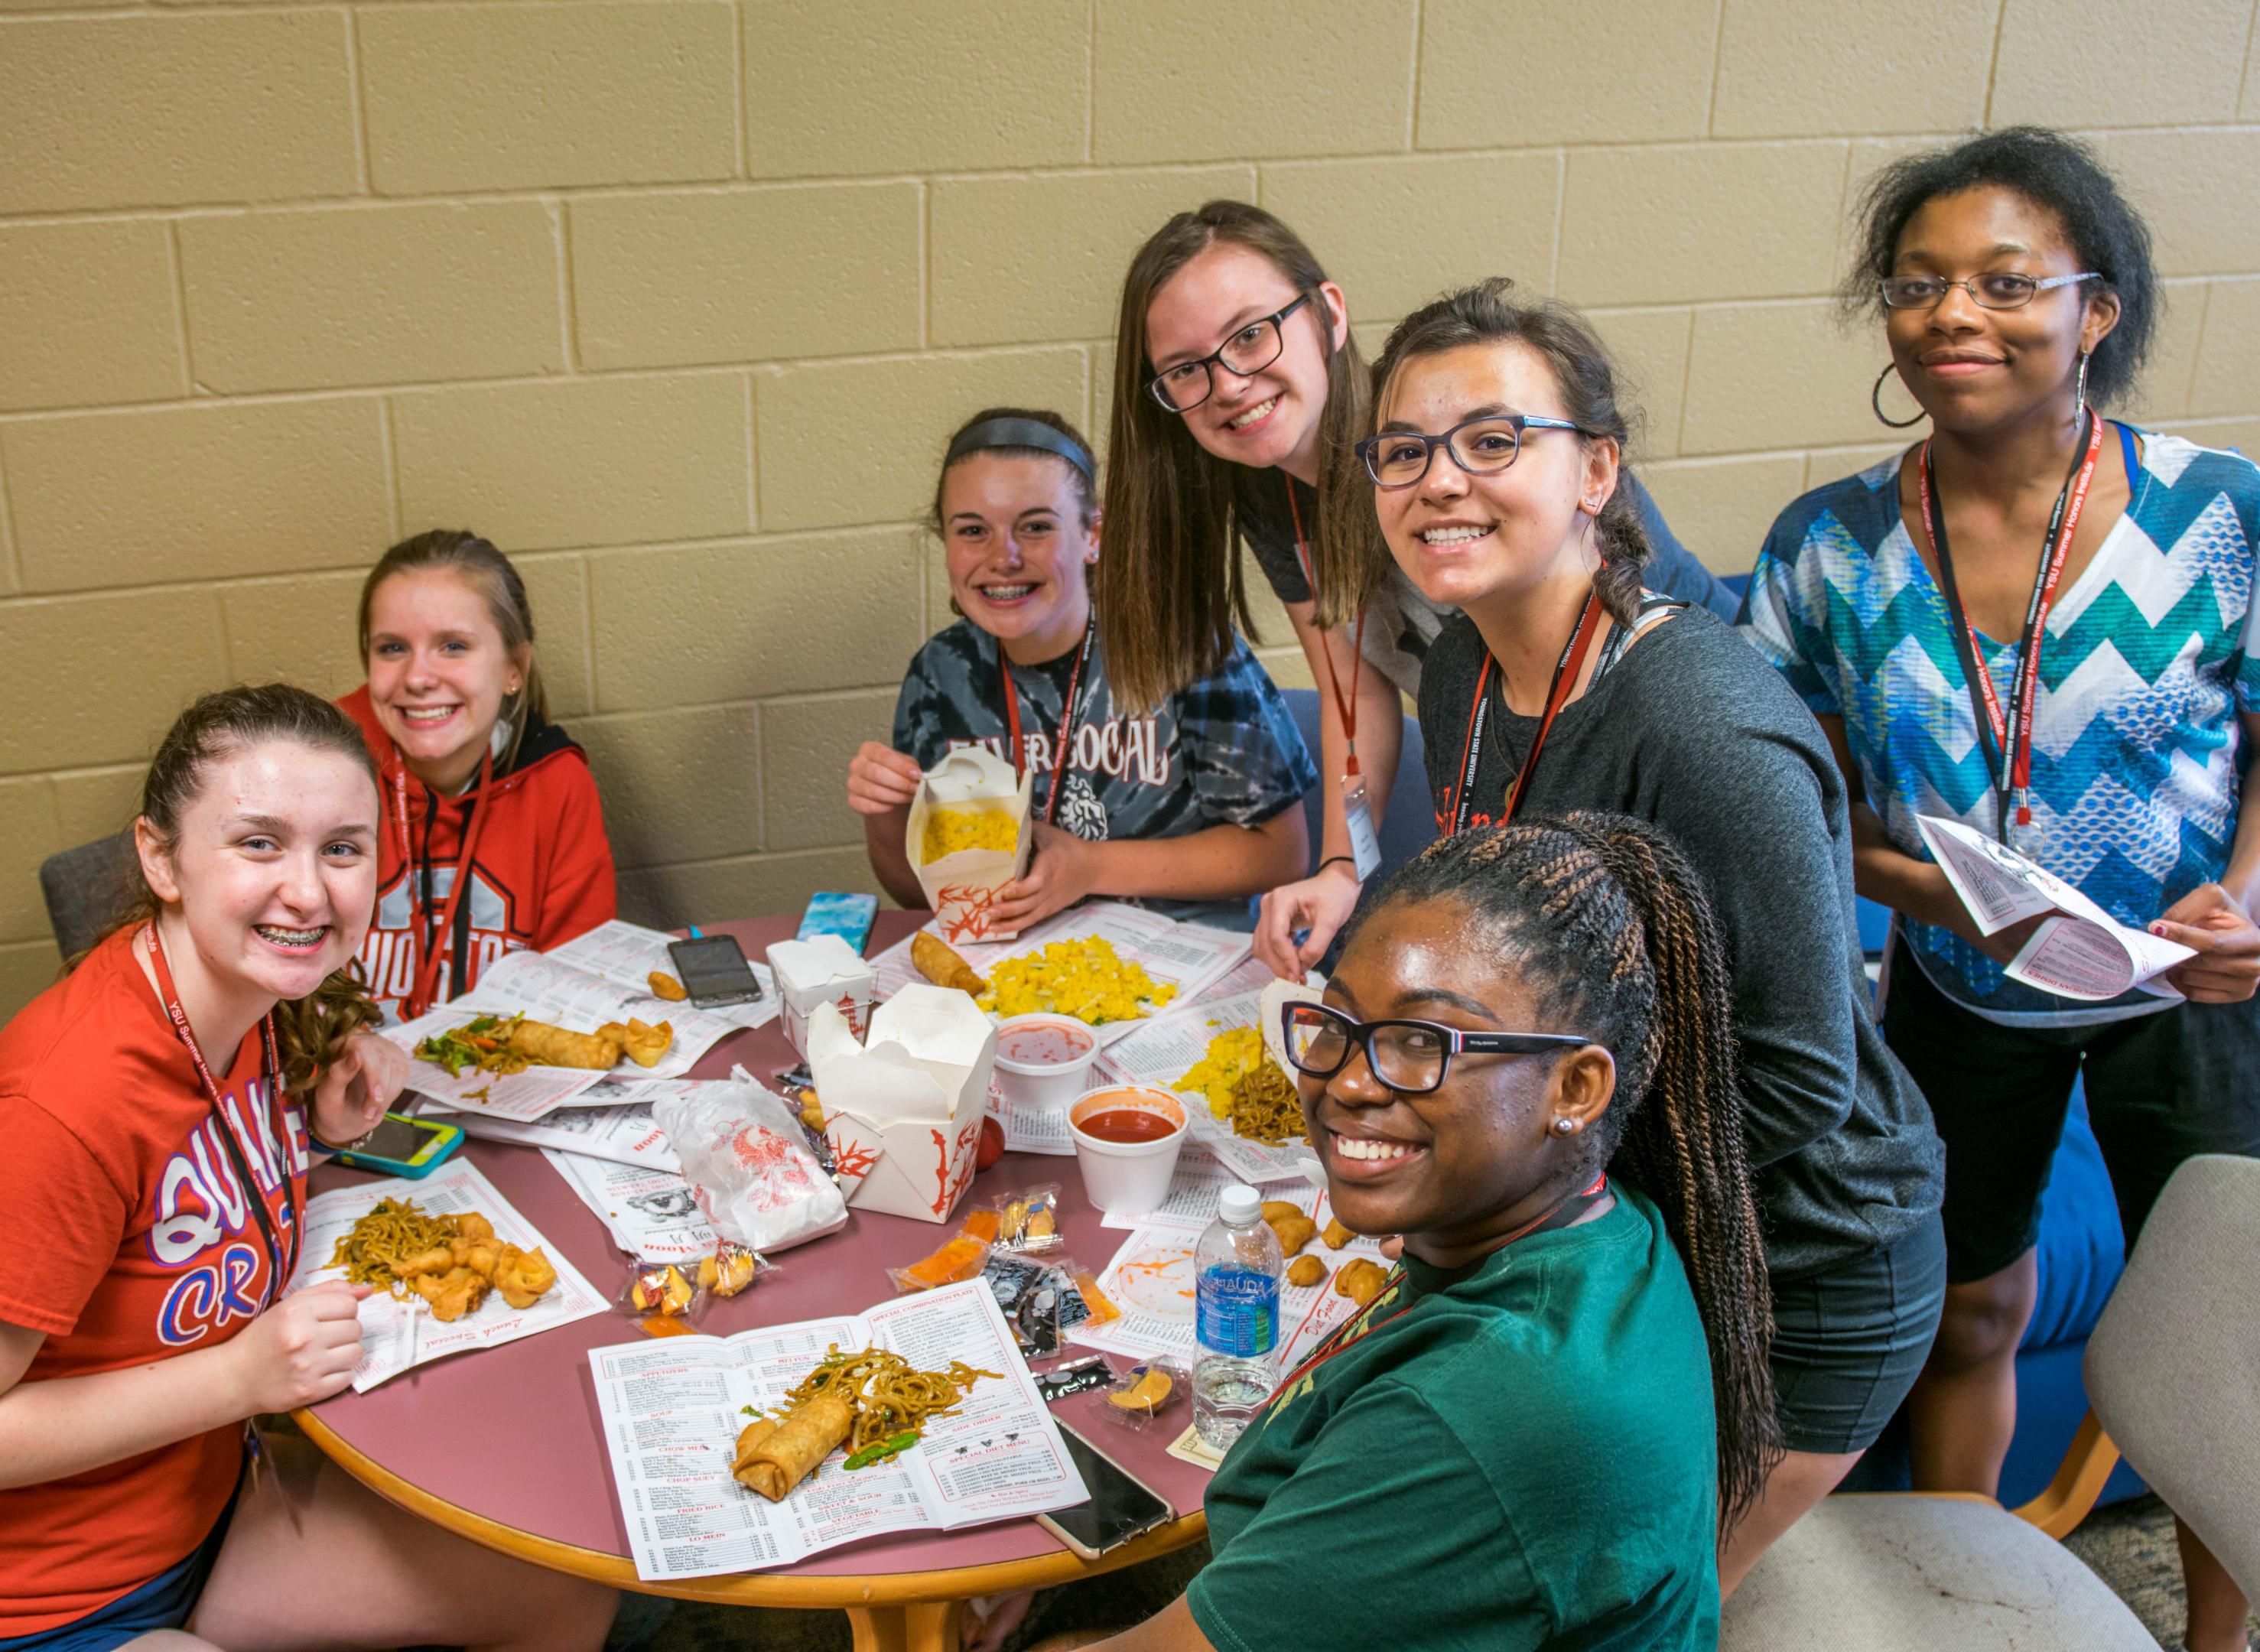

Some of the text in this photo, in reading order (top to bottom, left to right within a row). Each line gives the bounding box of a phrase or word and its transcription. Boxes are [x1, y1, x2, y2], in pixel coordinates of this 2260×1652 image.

[2090, 433, 2102, 450] YSU
[2045, 460, 2094, 590] YSU Summer Honors Institute
[2020, 601, 2049, 737] YSU Summer Honors Institute
[1977, 667, 2005, 736] Honors Institute
[1473, 697, 1488, 737] YOUNGSTOWN
[1471, 737, 1481, 754] STATE
[1465, 753, 1478, 788] UNIVERSITY
[2027, 970, 2057, 987] DISHES
[169, 1000, 186, 1026] YSU
[178, 1025, 202, 1065] Summer
[200, 1063, 218, 1097] Honors
[643, 1243, 695, 1255] Moon
[873, 1289, 974, 1322] SPECIAL COMBINATION PLATE
[1305, 1299, 1339, 1336] Diet Food
[424, 1317, 525, 1349] Lunch Special
[641, 1367, 689, 1377] APPETIZERS
[650, 1409, 673, 1418] SOUP
[951, 1423, 971, 1432] SIDE
[972, 1415, 1002, 1427] ORDER
[949, 1439, 1030, 1464] SPECIAL DIET MENU
[818, 1501, 847, 1511] SWEET
[857, 1493, 882, 1502] SOUR
[831, 1509, 880, 1524] VEGETABLE
[703, 1532, 726, 1540] MEIN
